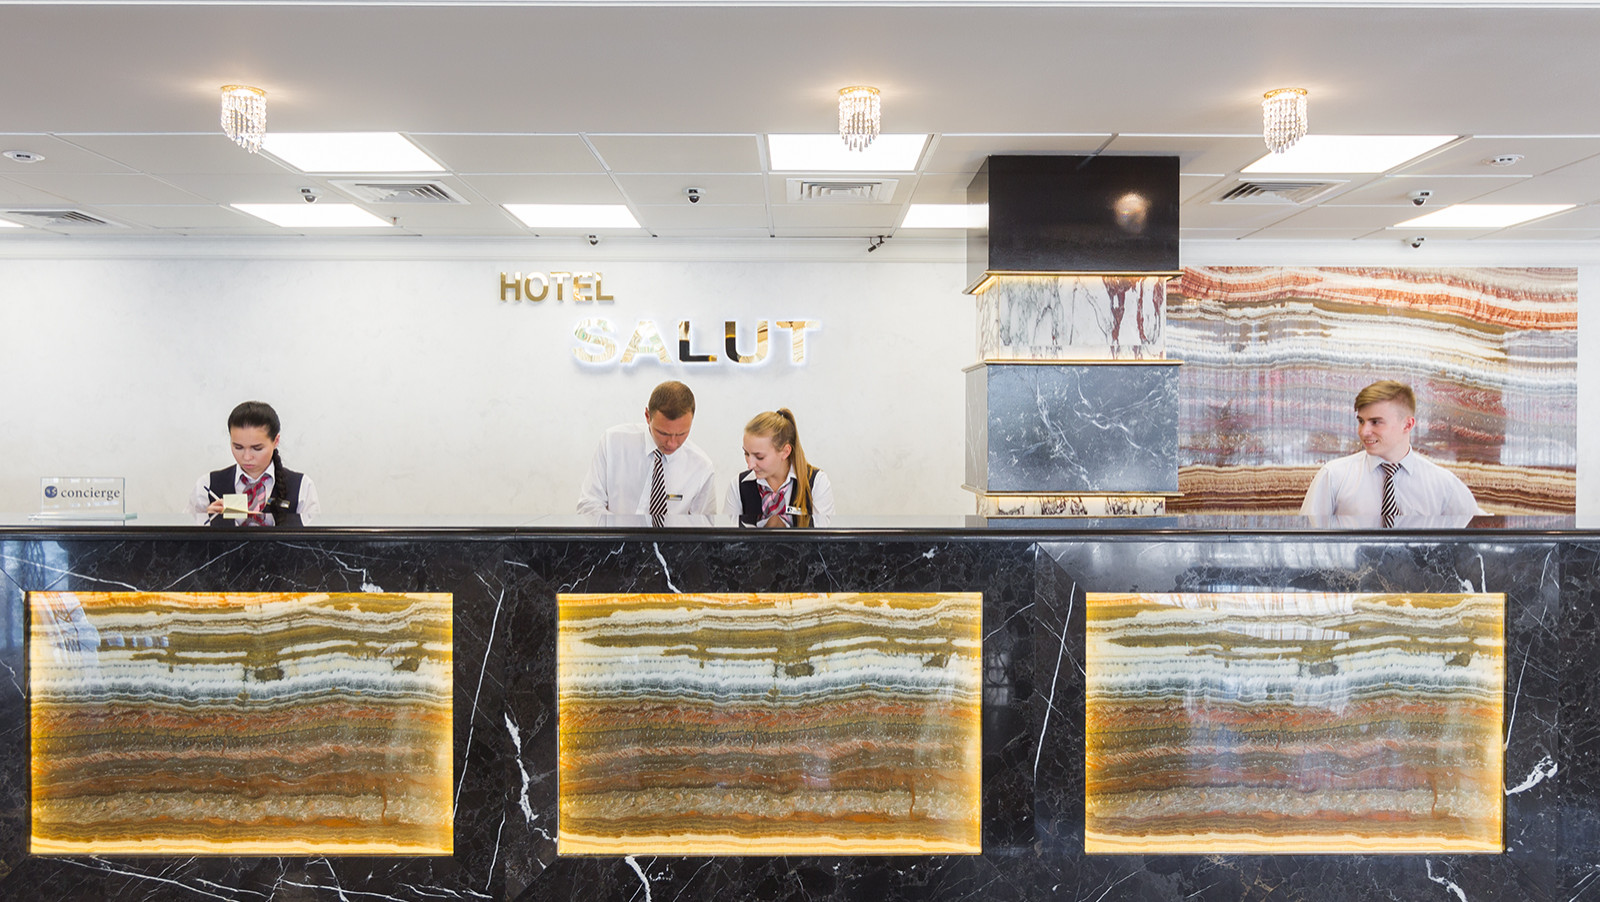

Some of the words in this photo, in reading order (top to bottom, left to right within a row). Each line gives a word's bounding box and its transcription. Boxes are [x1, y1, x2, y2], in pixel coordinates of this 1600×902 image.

[500, 271, 614, 302] HOTEL
[572, 319, 820, 364] SALUT
[60, 487, 120, 501] concierge
